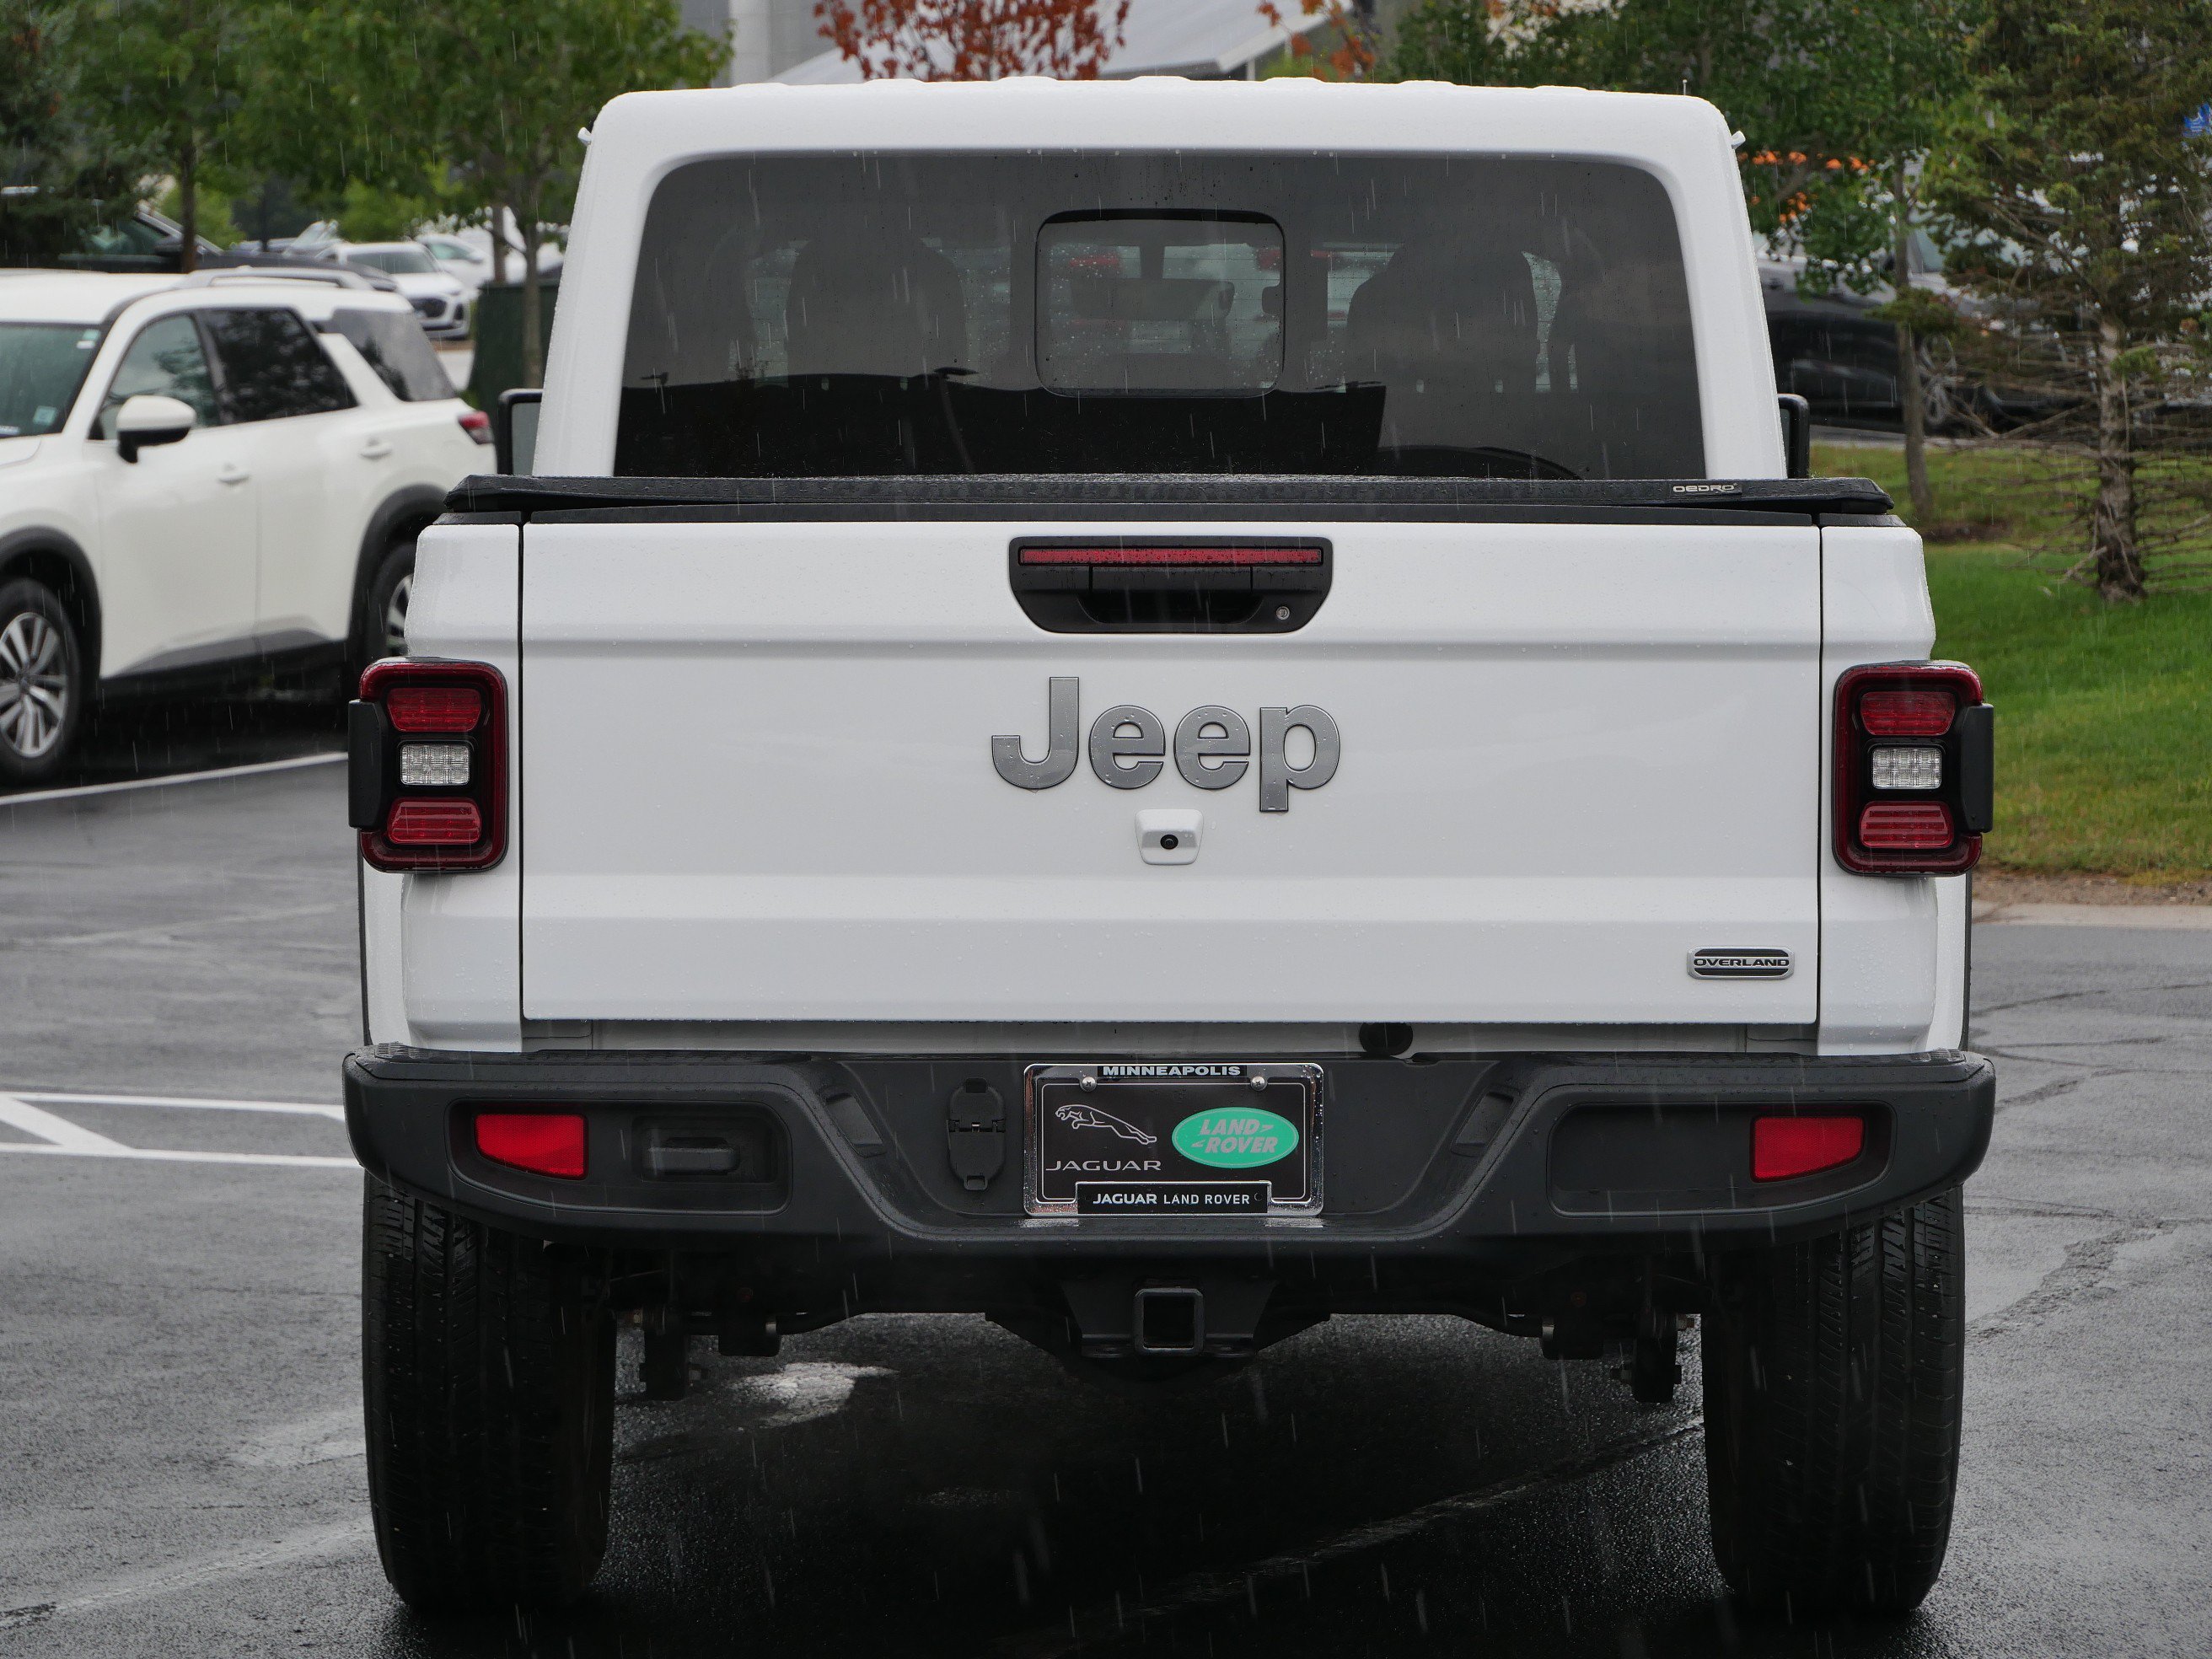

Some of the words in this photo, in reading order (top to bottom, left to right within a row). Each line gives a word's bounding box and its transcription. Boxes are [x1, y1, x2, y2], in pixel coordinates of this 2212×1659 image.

[991, 677, 1340, 812] Jeep
[1694, 958, 1790, 967] OVERLAND
[1103, 1066, 1241, 1076] MINNEAPOLIS
[1045, 1160, 1162, 1171] JAGUAR
[1093, 1193, 1157, 1205] JAGUAR
[1163, 1194, 1200, 1205] LAND
[1205, 1194, 1250, 1205] ROVER
